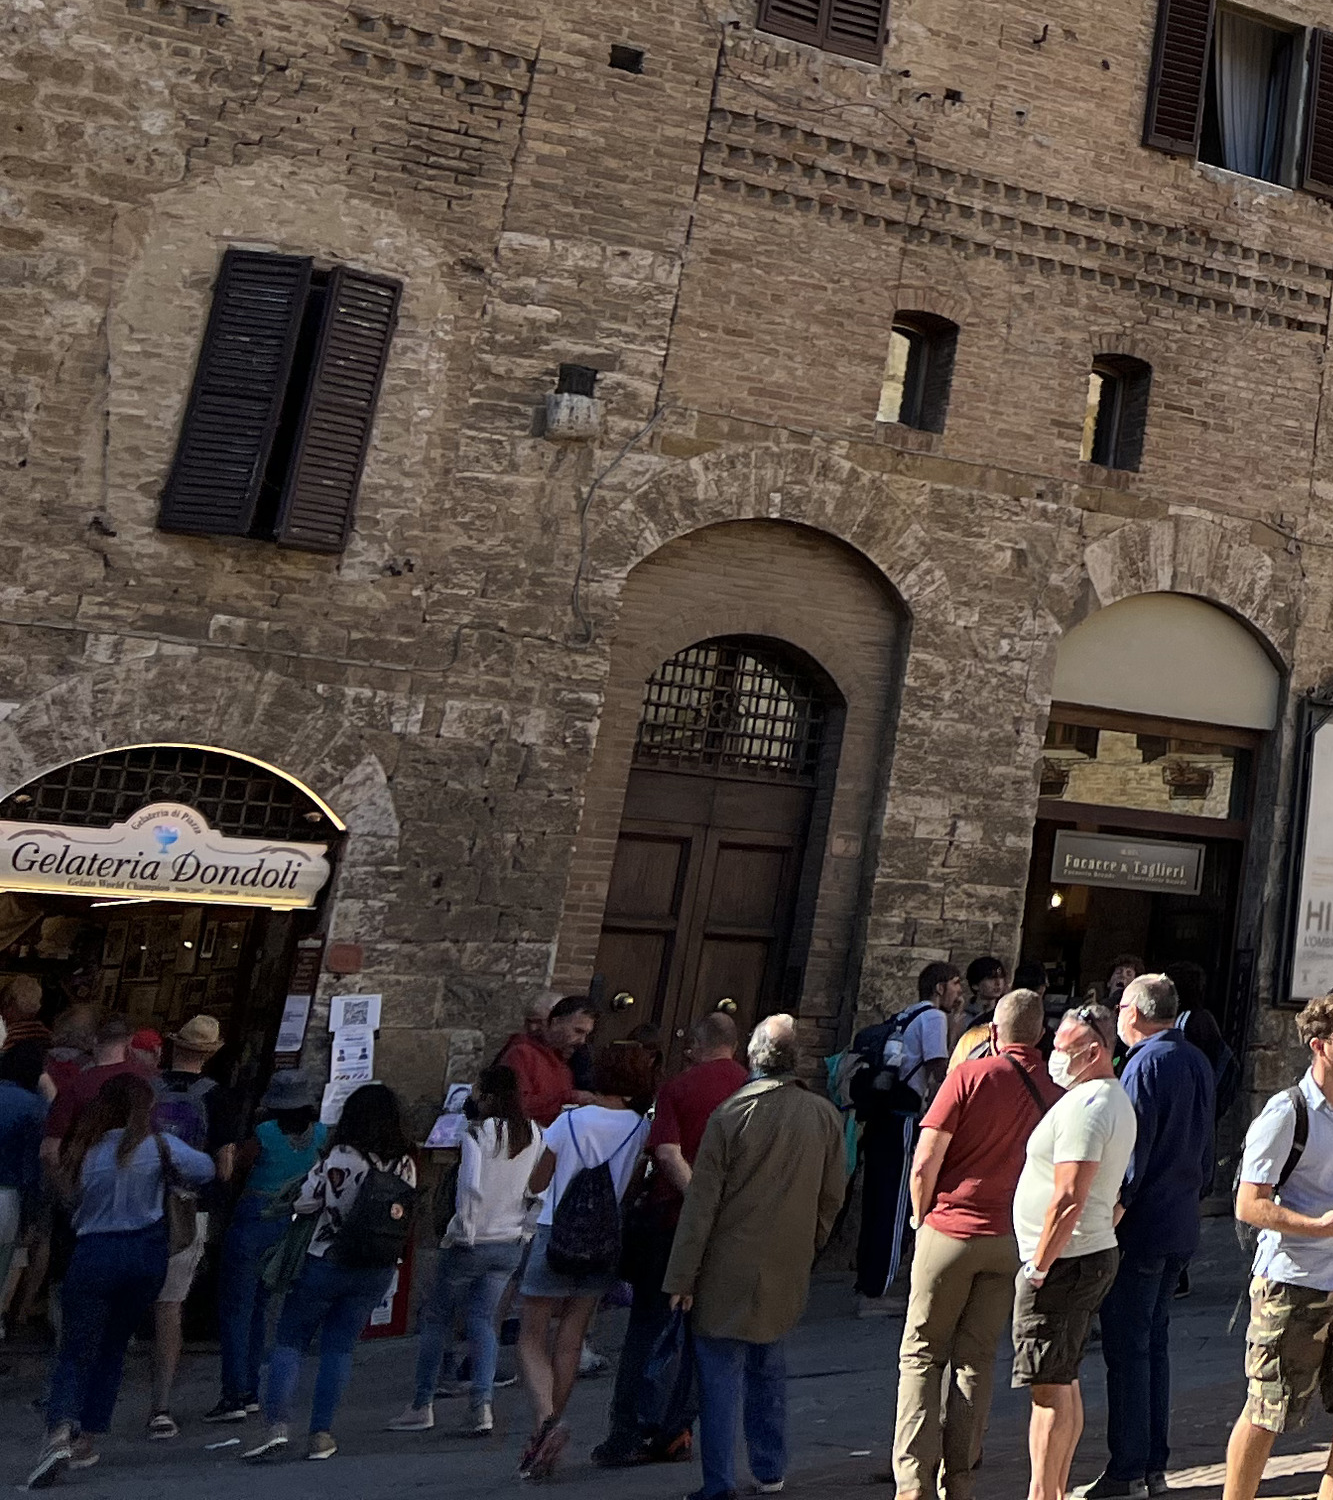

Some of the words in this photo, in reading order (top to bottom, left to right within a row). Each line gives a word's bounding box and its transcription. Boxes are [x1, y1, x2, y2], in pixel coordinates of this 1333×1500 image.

[131, 809, 169, 830] Gelateria
[171, 809, 181, 818] di
[12, 841, 161, 881] Gelateria
[169, 849, 302, 890] Dondoli
[1064, 854, 1117, 872] Focacce
[1133, 860, 1185, 878] Taglieri
[99, 879, 125, 890] World
